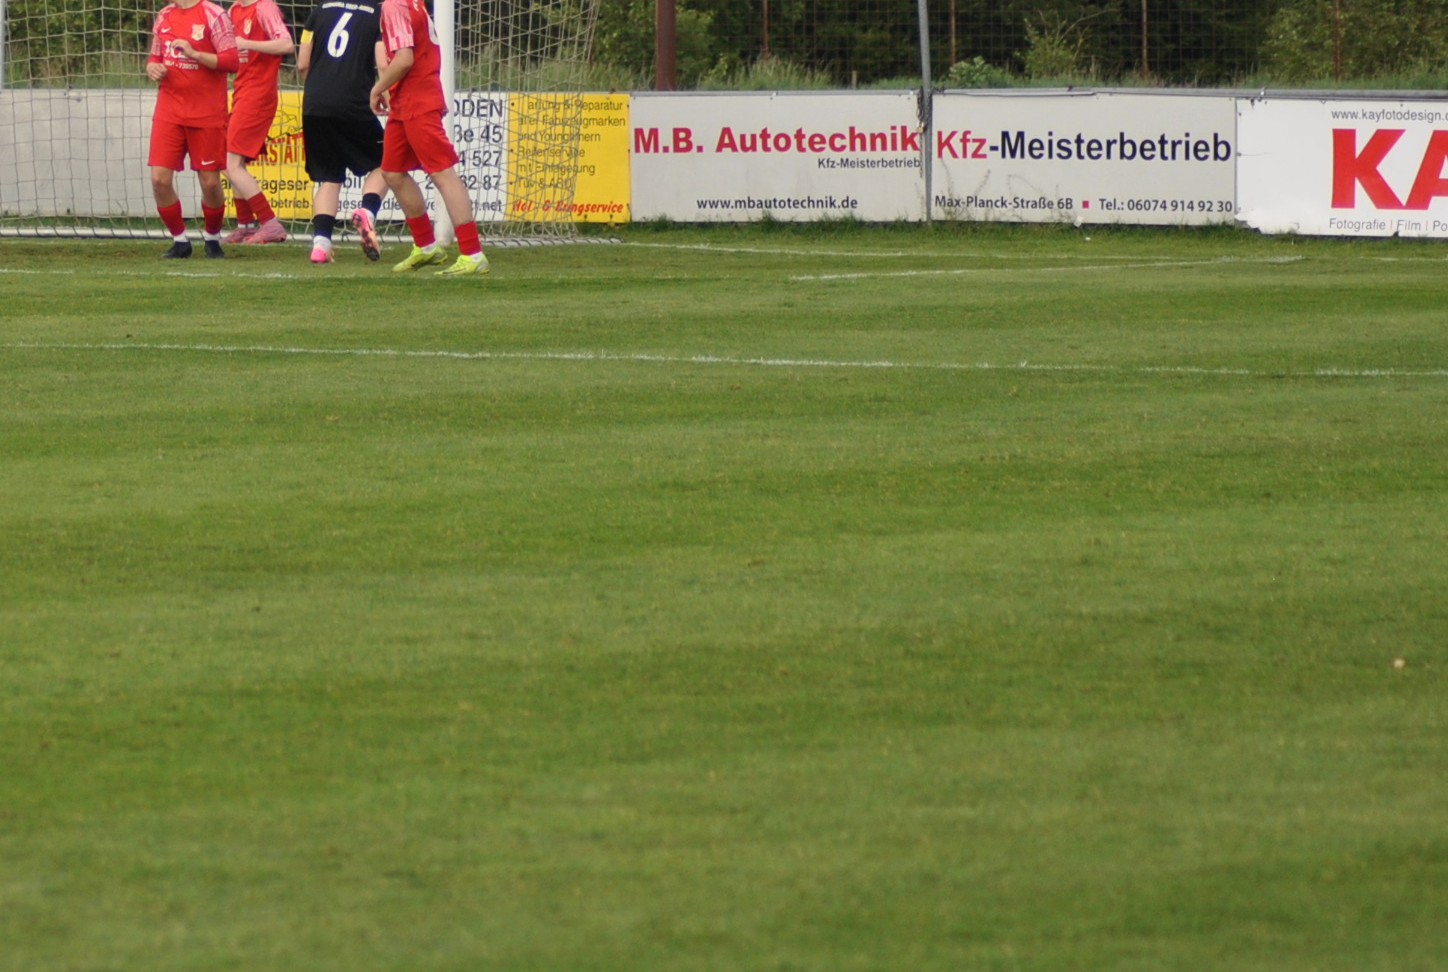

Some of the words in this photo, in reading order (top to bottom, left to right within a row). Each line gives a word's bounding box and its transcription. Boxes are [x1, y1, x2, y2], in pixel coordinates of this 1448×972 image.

[327, 12, 353, 58] 6
[481, 124, 502, 143] 45
[634, 127, 704, 153] M.B.
[715, 125, 920, 153] Autotechnik
[937, 130, 1232, 161] Kfz-Meisterbetrieb
[472, 150, 502, 167] 527
[817, 157, 921, 169] Kfz-Meisterbetrieb
[697, 196, 858, 210] www.mbautotechnik.de
[935, 195, 1054, 209] Max-Planck-Straße
[1057, 198, 1073, 209] 6B
[1099, 198, 1124, 212] Tel.:
[1127, 198, 1167, 212] 06074
[1171, 198, 1195, 212] 914
[1198, 198, 1214, 213] 92
[1217, 199, 1232, 213] 30
[1329, 218, 1386, 232] Fotografie
[1397, 220, 1421, 231] Film
